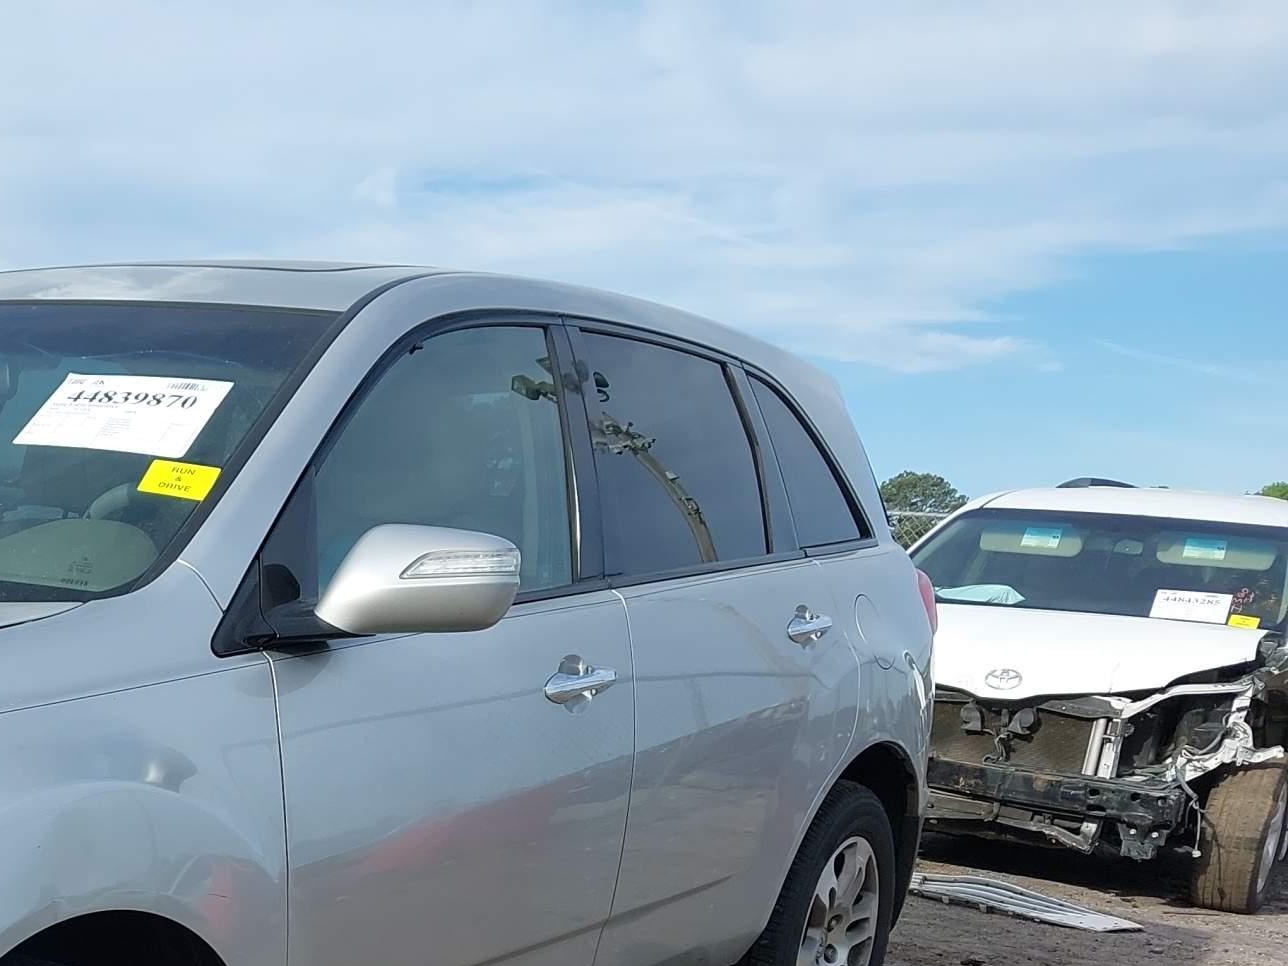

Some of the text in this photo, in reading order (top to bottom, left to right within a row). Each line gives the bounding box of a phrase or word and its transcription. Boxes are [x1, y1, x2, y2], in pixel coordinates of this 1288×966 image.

[67, 390, 198, 410] 44839870
[171, 466, 196, 476] RUN
[158, 481, 192, 492] DRIVE
